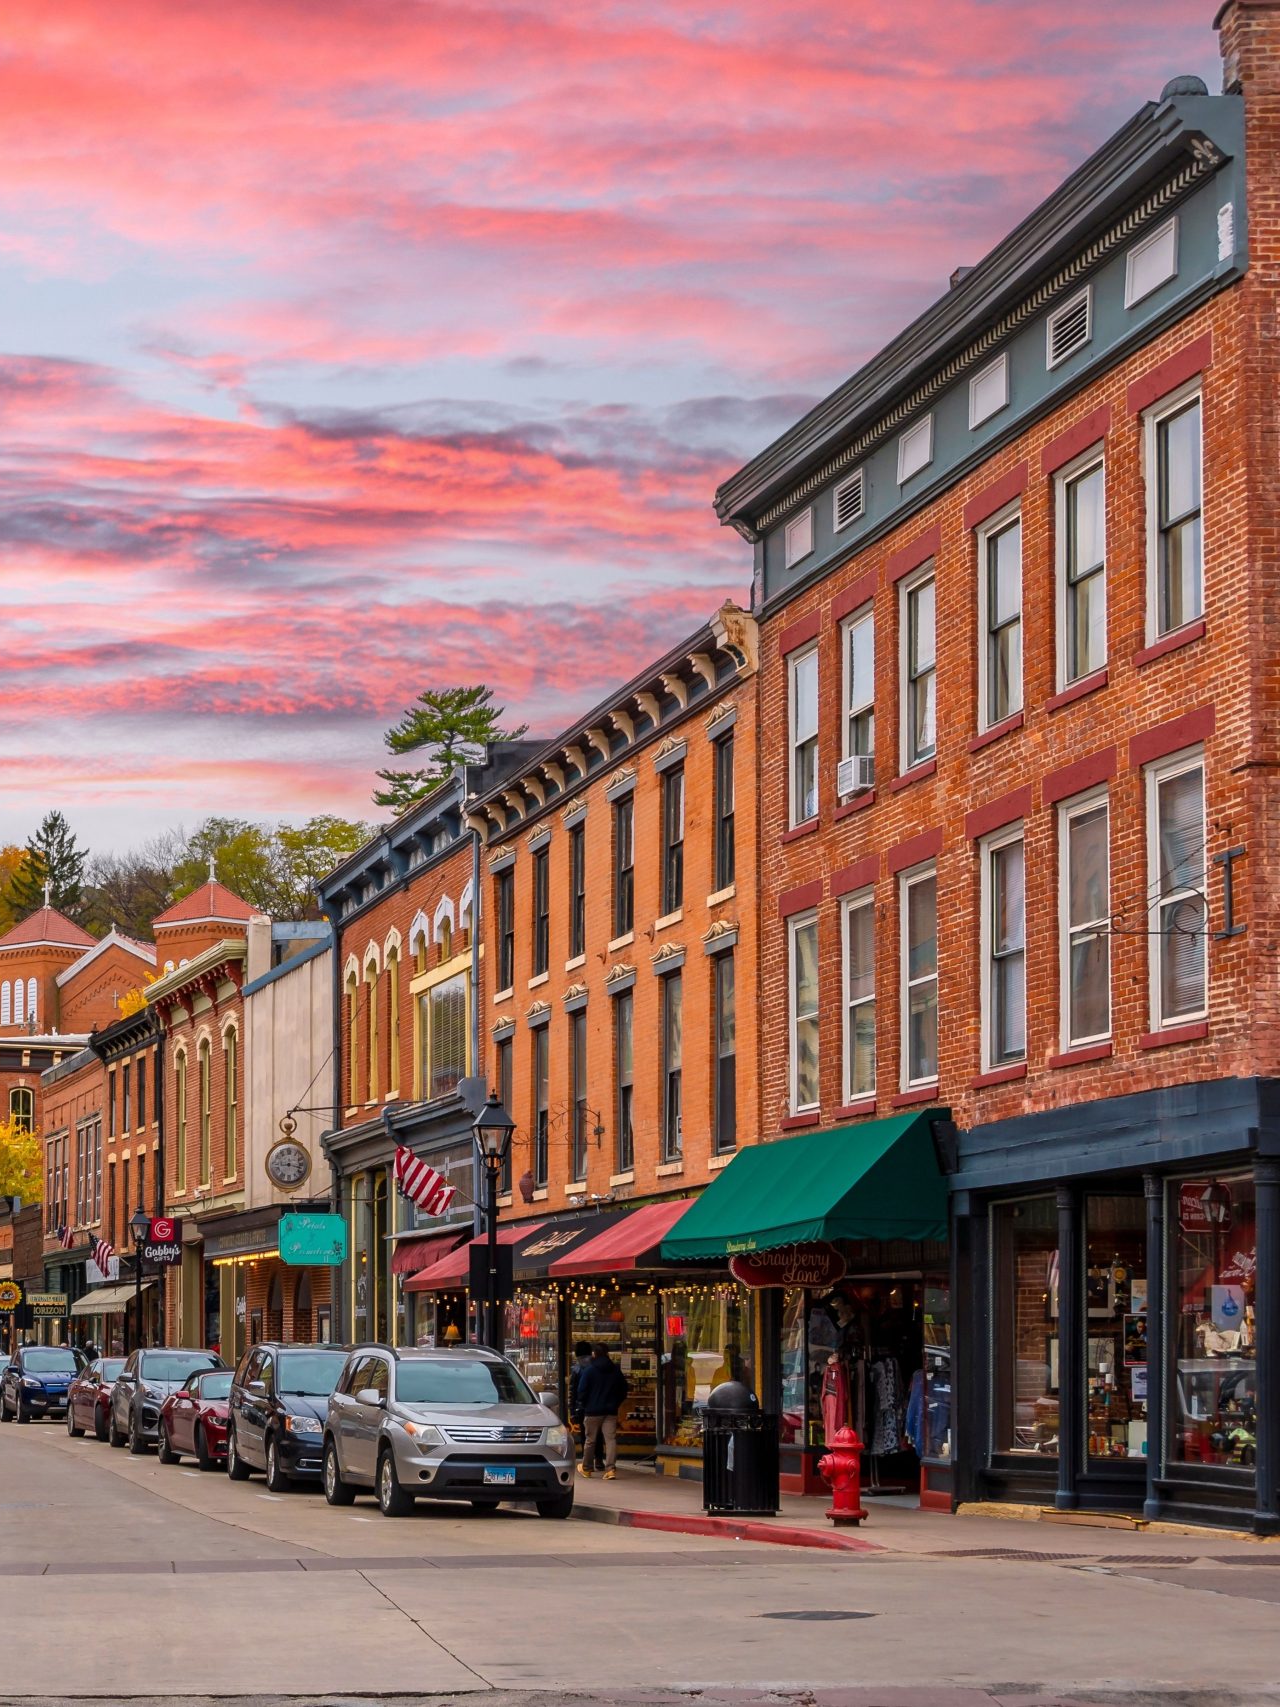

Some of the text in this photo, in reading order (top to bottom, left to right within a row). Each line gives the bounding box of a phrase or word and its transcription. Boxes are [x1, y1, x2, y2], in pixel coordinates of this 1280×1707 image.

[154, 1221, 171, 1238] G
[144, 1244, 181, 1261] Gabby's
[749, 1252, 831, 1276] Strawberry
[782, 1263, 821, 1283] Lane
